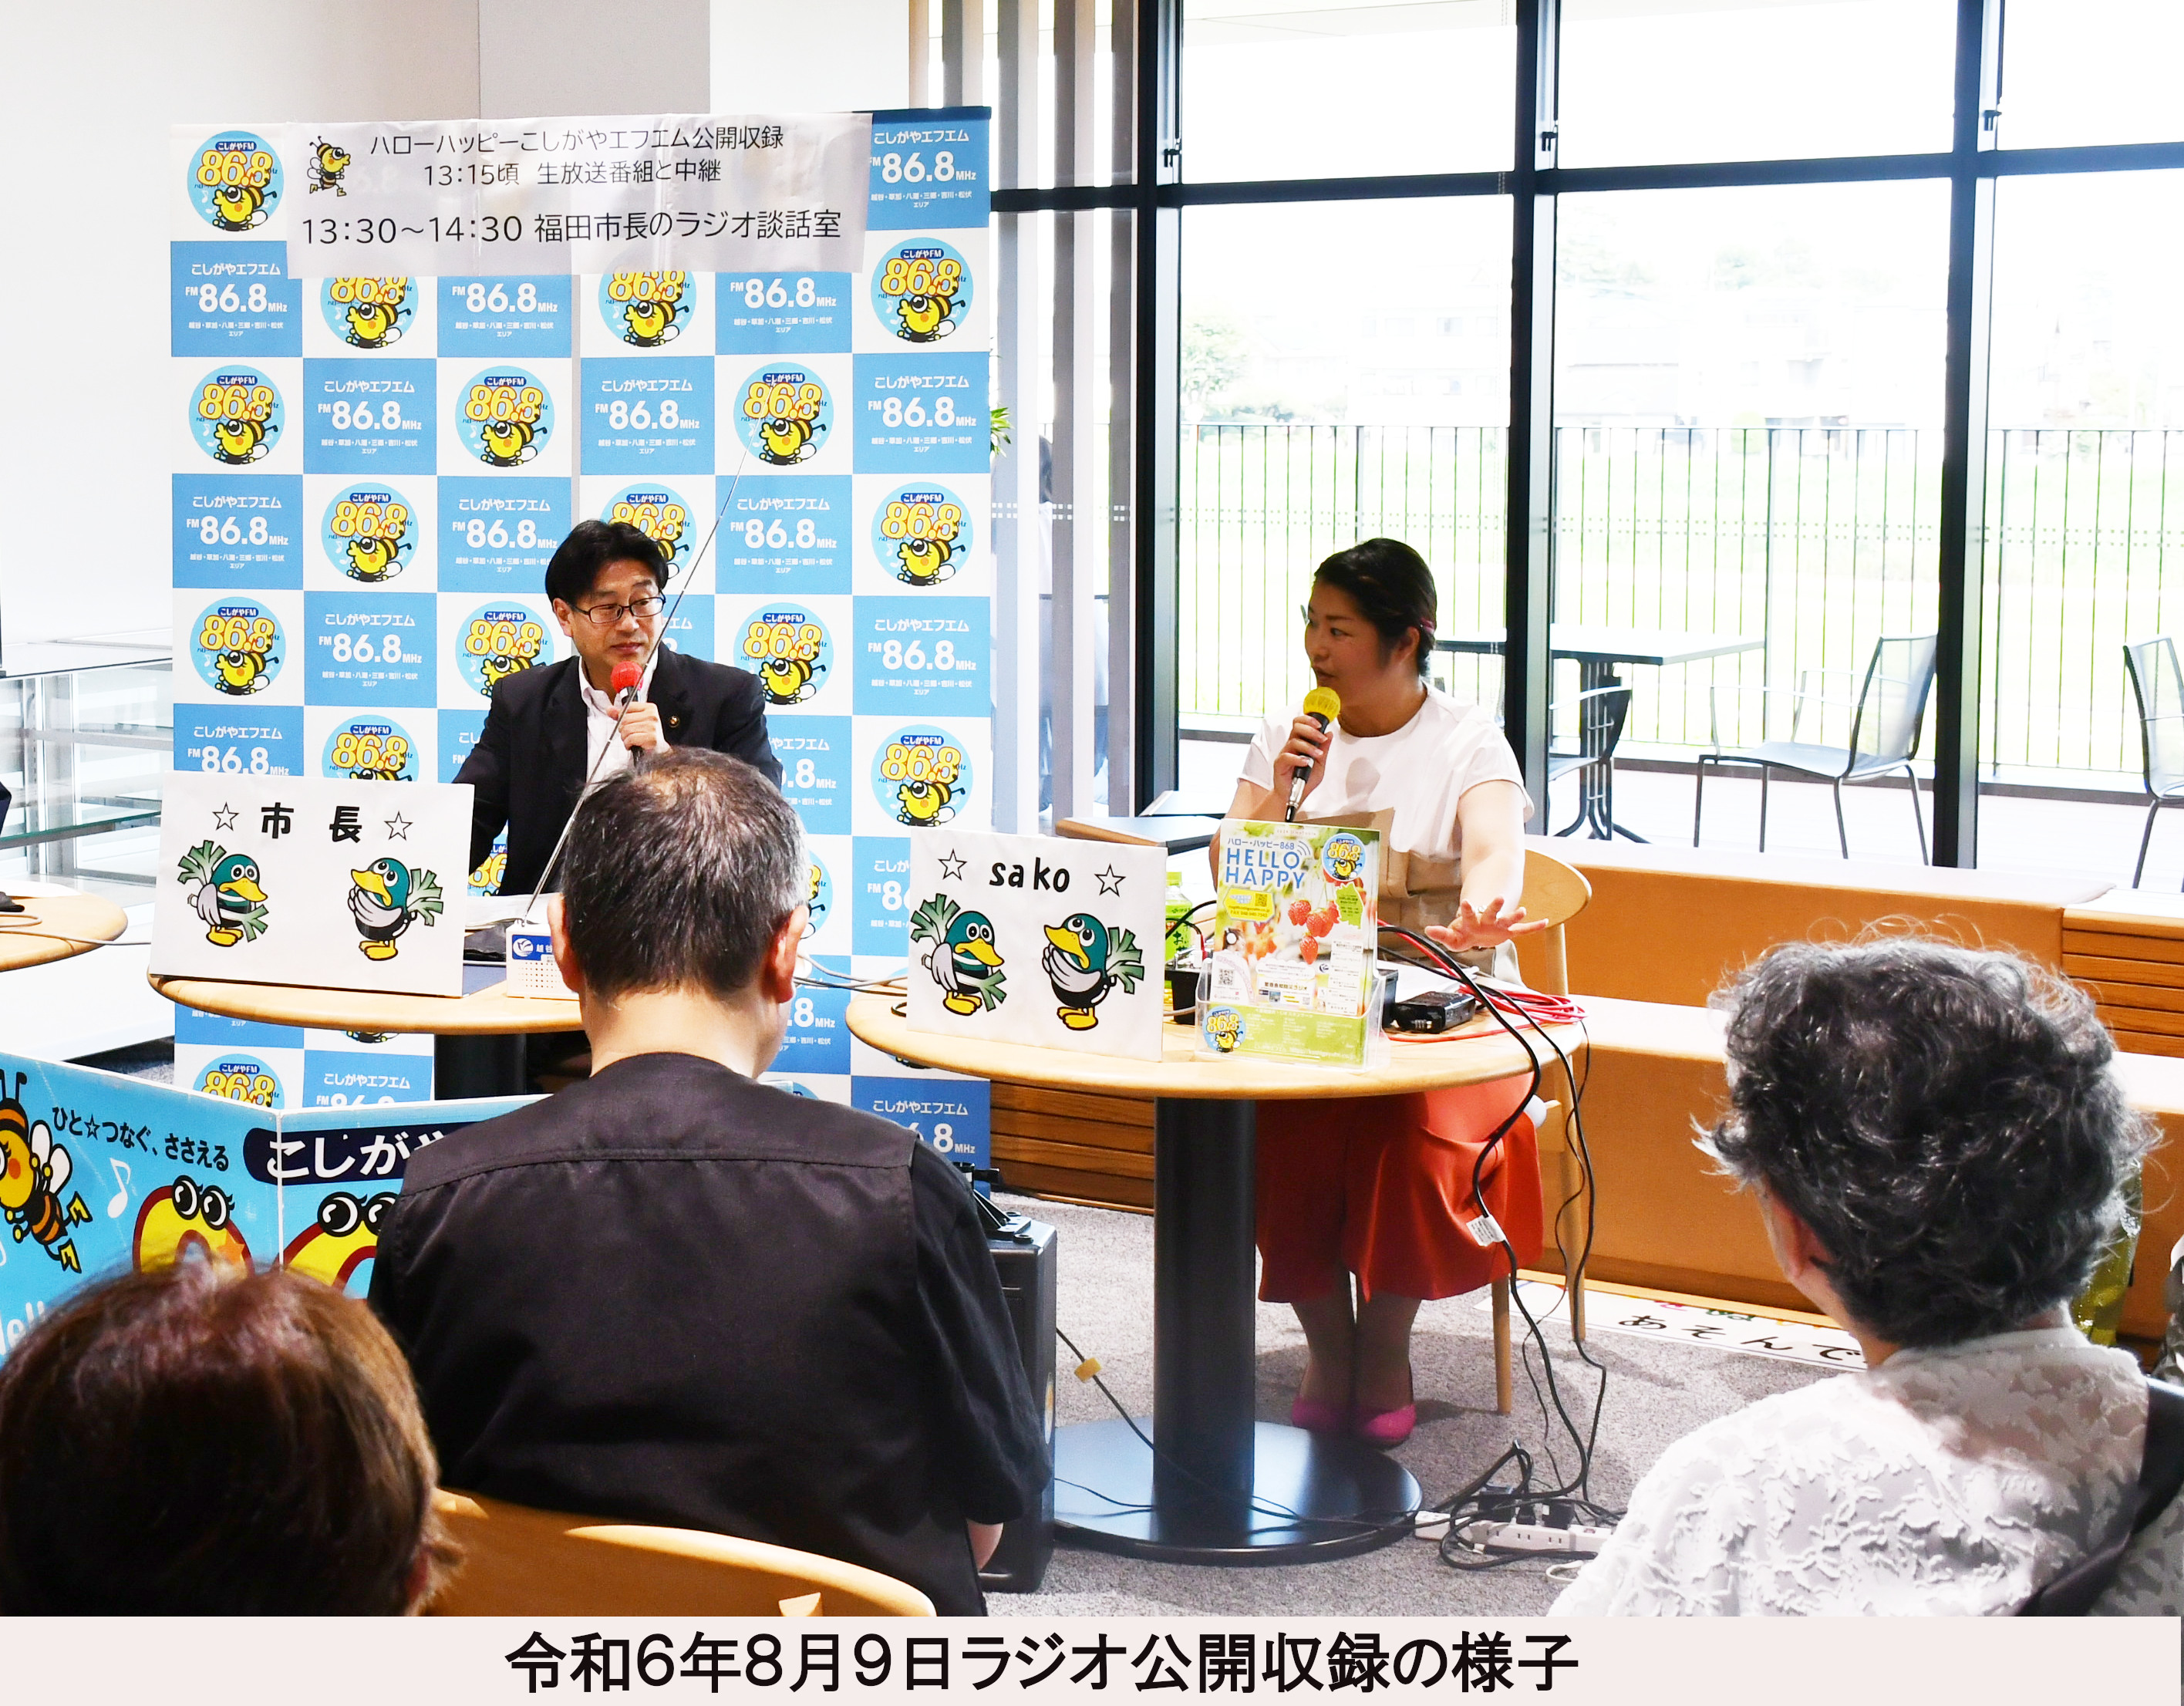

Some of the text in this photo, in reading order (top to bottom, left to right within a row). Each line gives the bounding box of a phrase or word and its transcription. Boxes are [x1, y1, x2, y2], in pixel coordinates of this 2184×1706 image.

[371, 126, 783, 154] ハローハッピーこしがやエフエム公開収録
[873, 130, 969, 143] こしがやエフエム
[217, 143, 254, 151] こしがやFM
[425, 158, 720, 185] 13:15頃 生放送番組と中継
[534, 209, 841, 242] 福田市長のラジオ談話室
[904, 248, 942, 259] こしがやFM
[192, 263, 281, 275] こしがやエフエム
[219, 377, 255, 386] こしがやFM
[766, 374, 803, 383] こしがやFM
[875, 376, 969, 389] こしがやエフエム
[325, 380, 415, 393] こしがやエフエム
[602, 379, 693, 392] こしがやエフエム
[193, 496, 281, 508] こしがやエフエム
[352, 494, 389, 503] こしがやFM
[737, 498, 830, 511] こしがやエフエム
[904, 494, 942, 503] こしがやFM
[459, 499, 551, 511] こしがやエフエム
[221, 609, 256, 617] こしがやFM
[487, 613, 523, 622] こしがやFM
[766, 615, 803, 623] こしがやFM
[325, 614, 415, 626] こしがやエフエム
[875, 619, 969, 632] こしがやエフエム
[194, 727, 282, 739] こしがやエフエム
[353, 727, 389, 735] こしがやFM
[904, 737, 942, 745] こしがやFM
[1227, 848, 1299, 869] HELLO
[989, 857, 1070, 892] sako
[1226, 866, 1305, 888] HAPPY
[222, 1064, 258, 1074] こしがやFM
[324, 1073, 410, 1088] こしがやエフエム
[873, 1101, 968, 1115] こしがやエフエム
